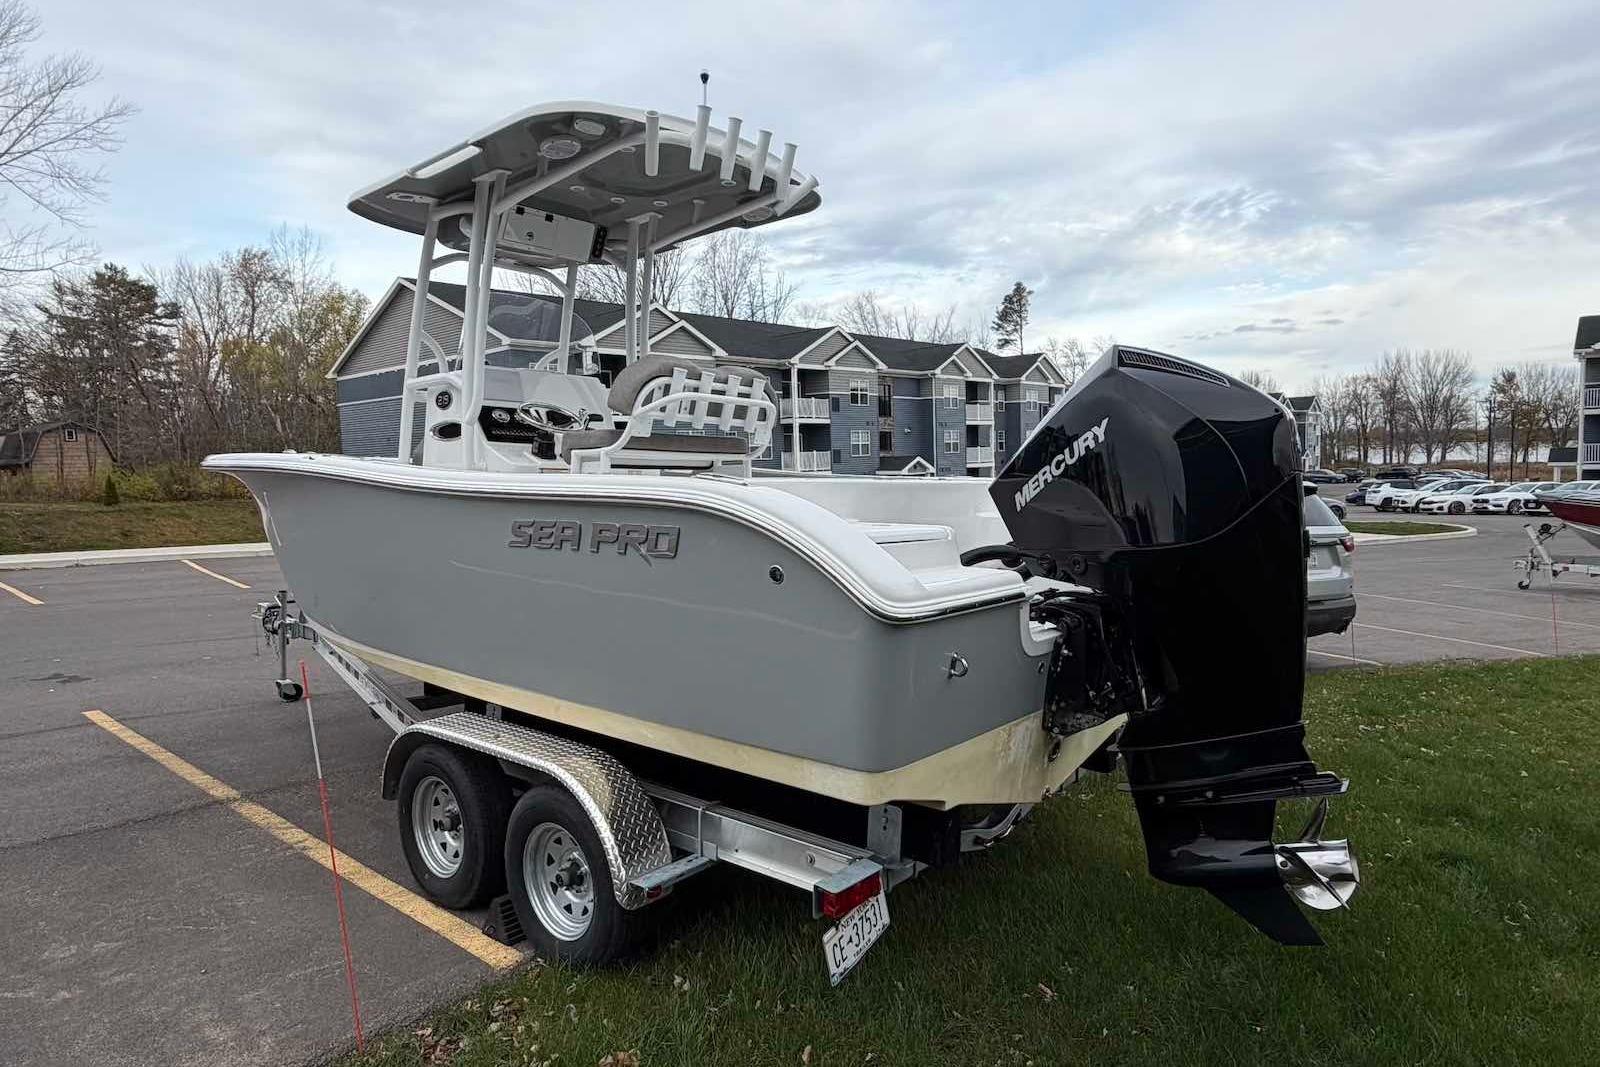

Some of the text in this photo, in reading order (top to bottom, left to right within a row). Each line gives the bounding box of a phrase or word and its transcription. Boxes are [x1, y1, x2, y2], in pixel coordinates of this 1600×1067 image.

[1014, 417, 1110, 512] MERCURY
[508, 519, 681, 567] SEA PRO
